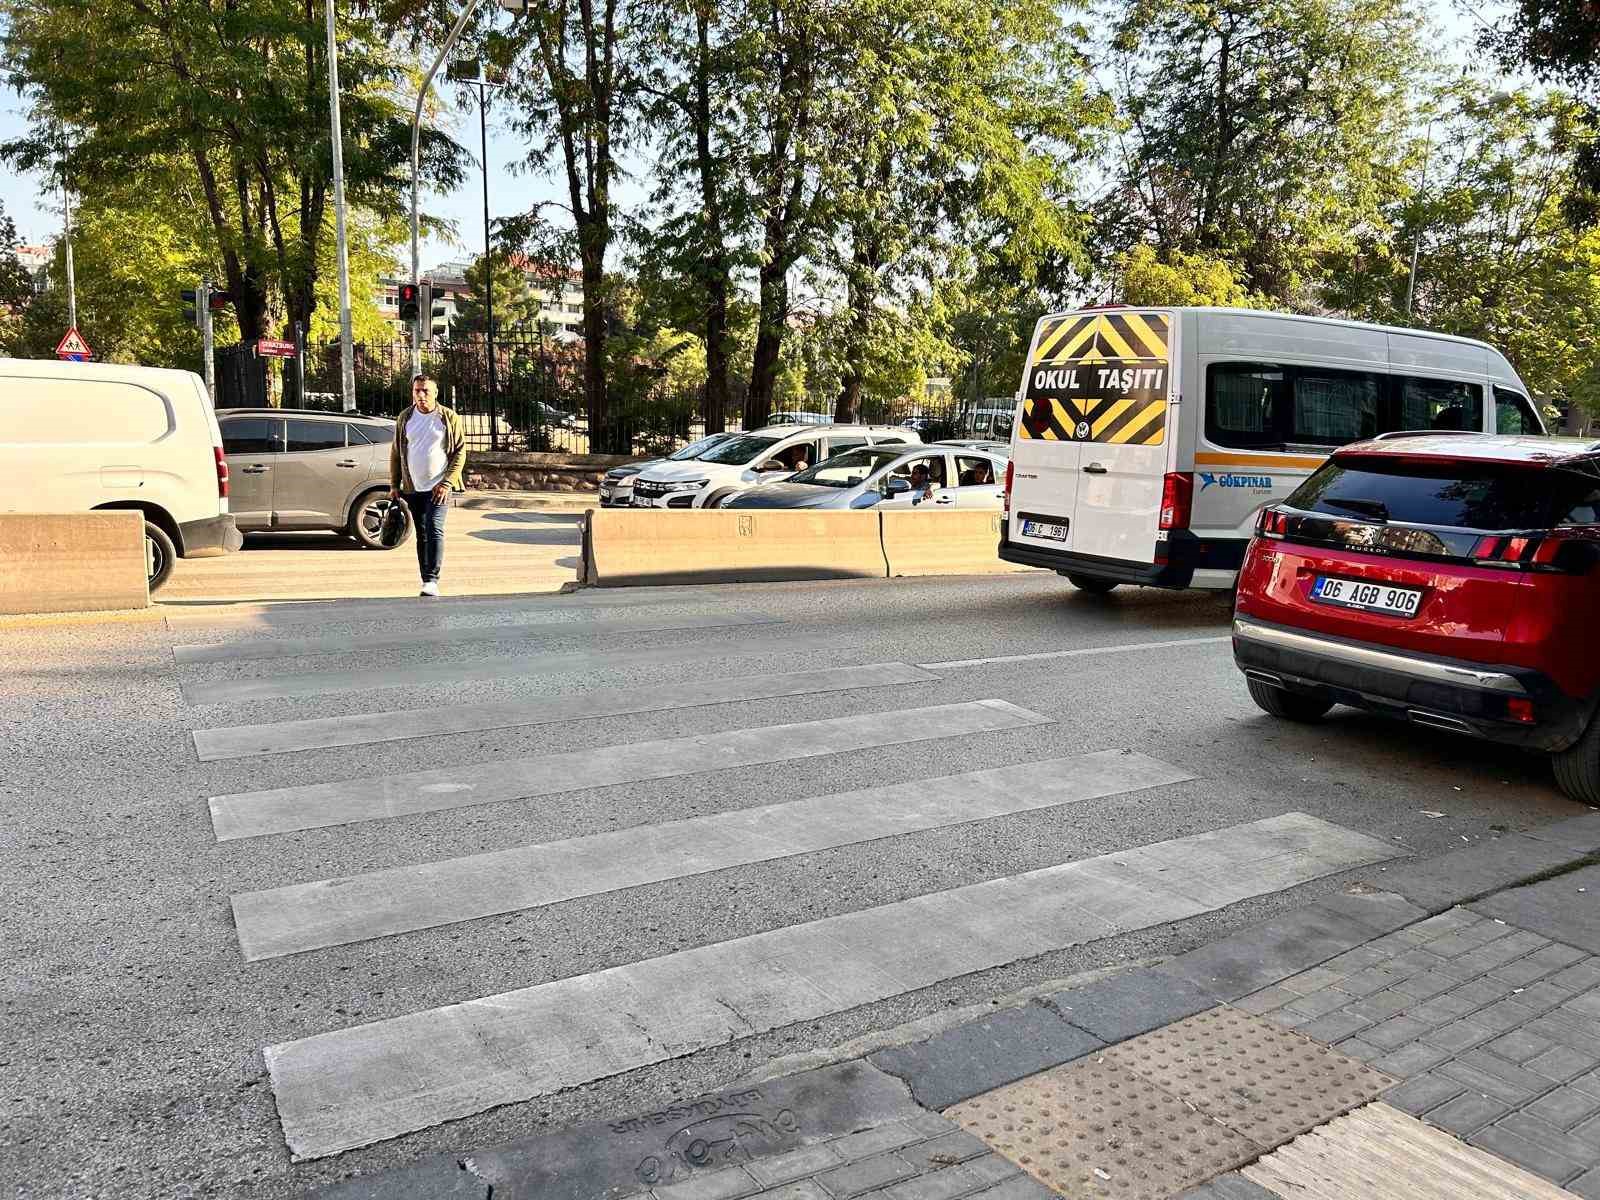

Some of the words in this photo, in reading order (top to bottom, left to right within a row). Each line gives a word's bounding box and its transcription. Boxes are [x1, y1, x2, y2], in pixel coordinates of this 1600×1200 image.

[1034, 369, 1080, 390] OKUL
[1097, 367, 1164, 394] TAŞITI
[1218, 472, 1272, 488] GÖKPINAR
[1050, 525, 1066, 538] 1961
[1345, 544, 1388, 554] PEUGEOT
[1323, 580, 1343, 598] 06
[1349, 584, 1379, 605] AGB
[1385, 590, 1418, 611] 906
